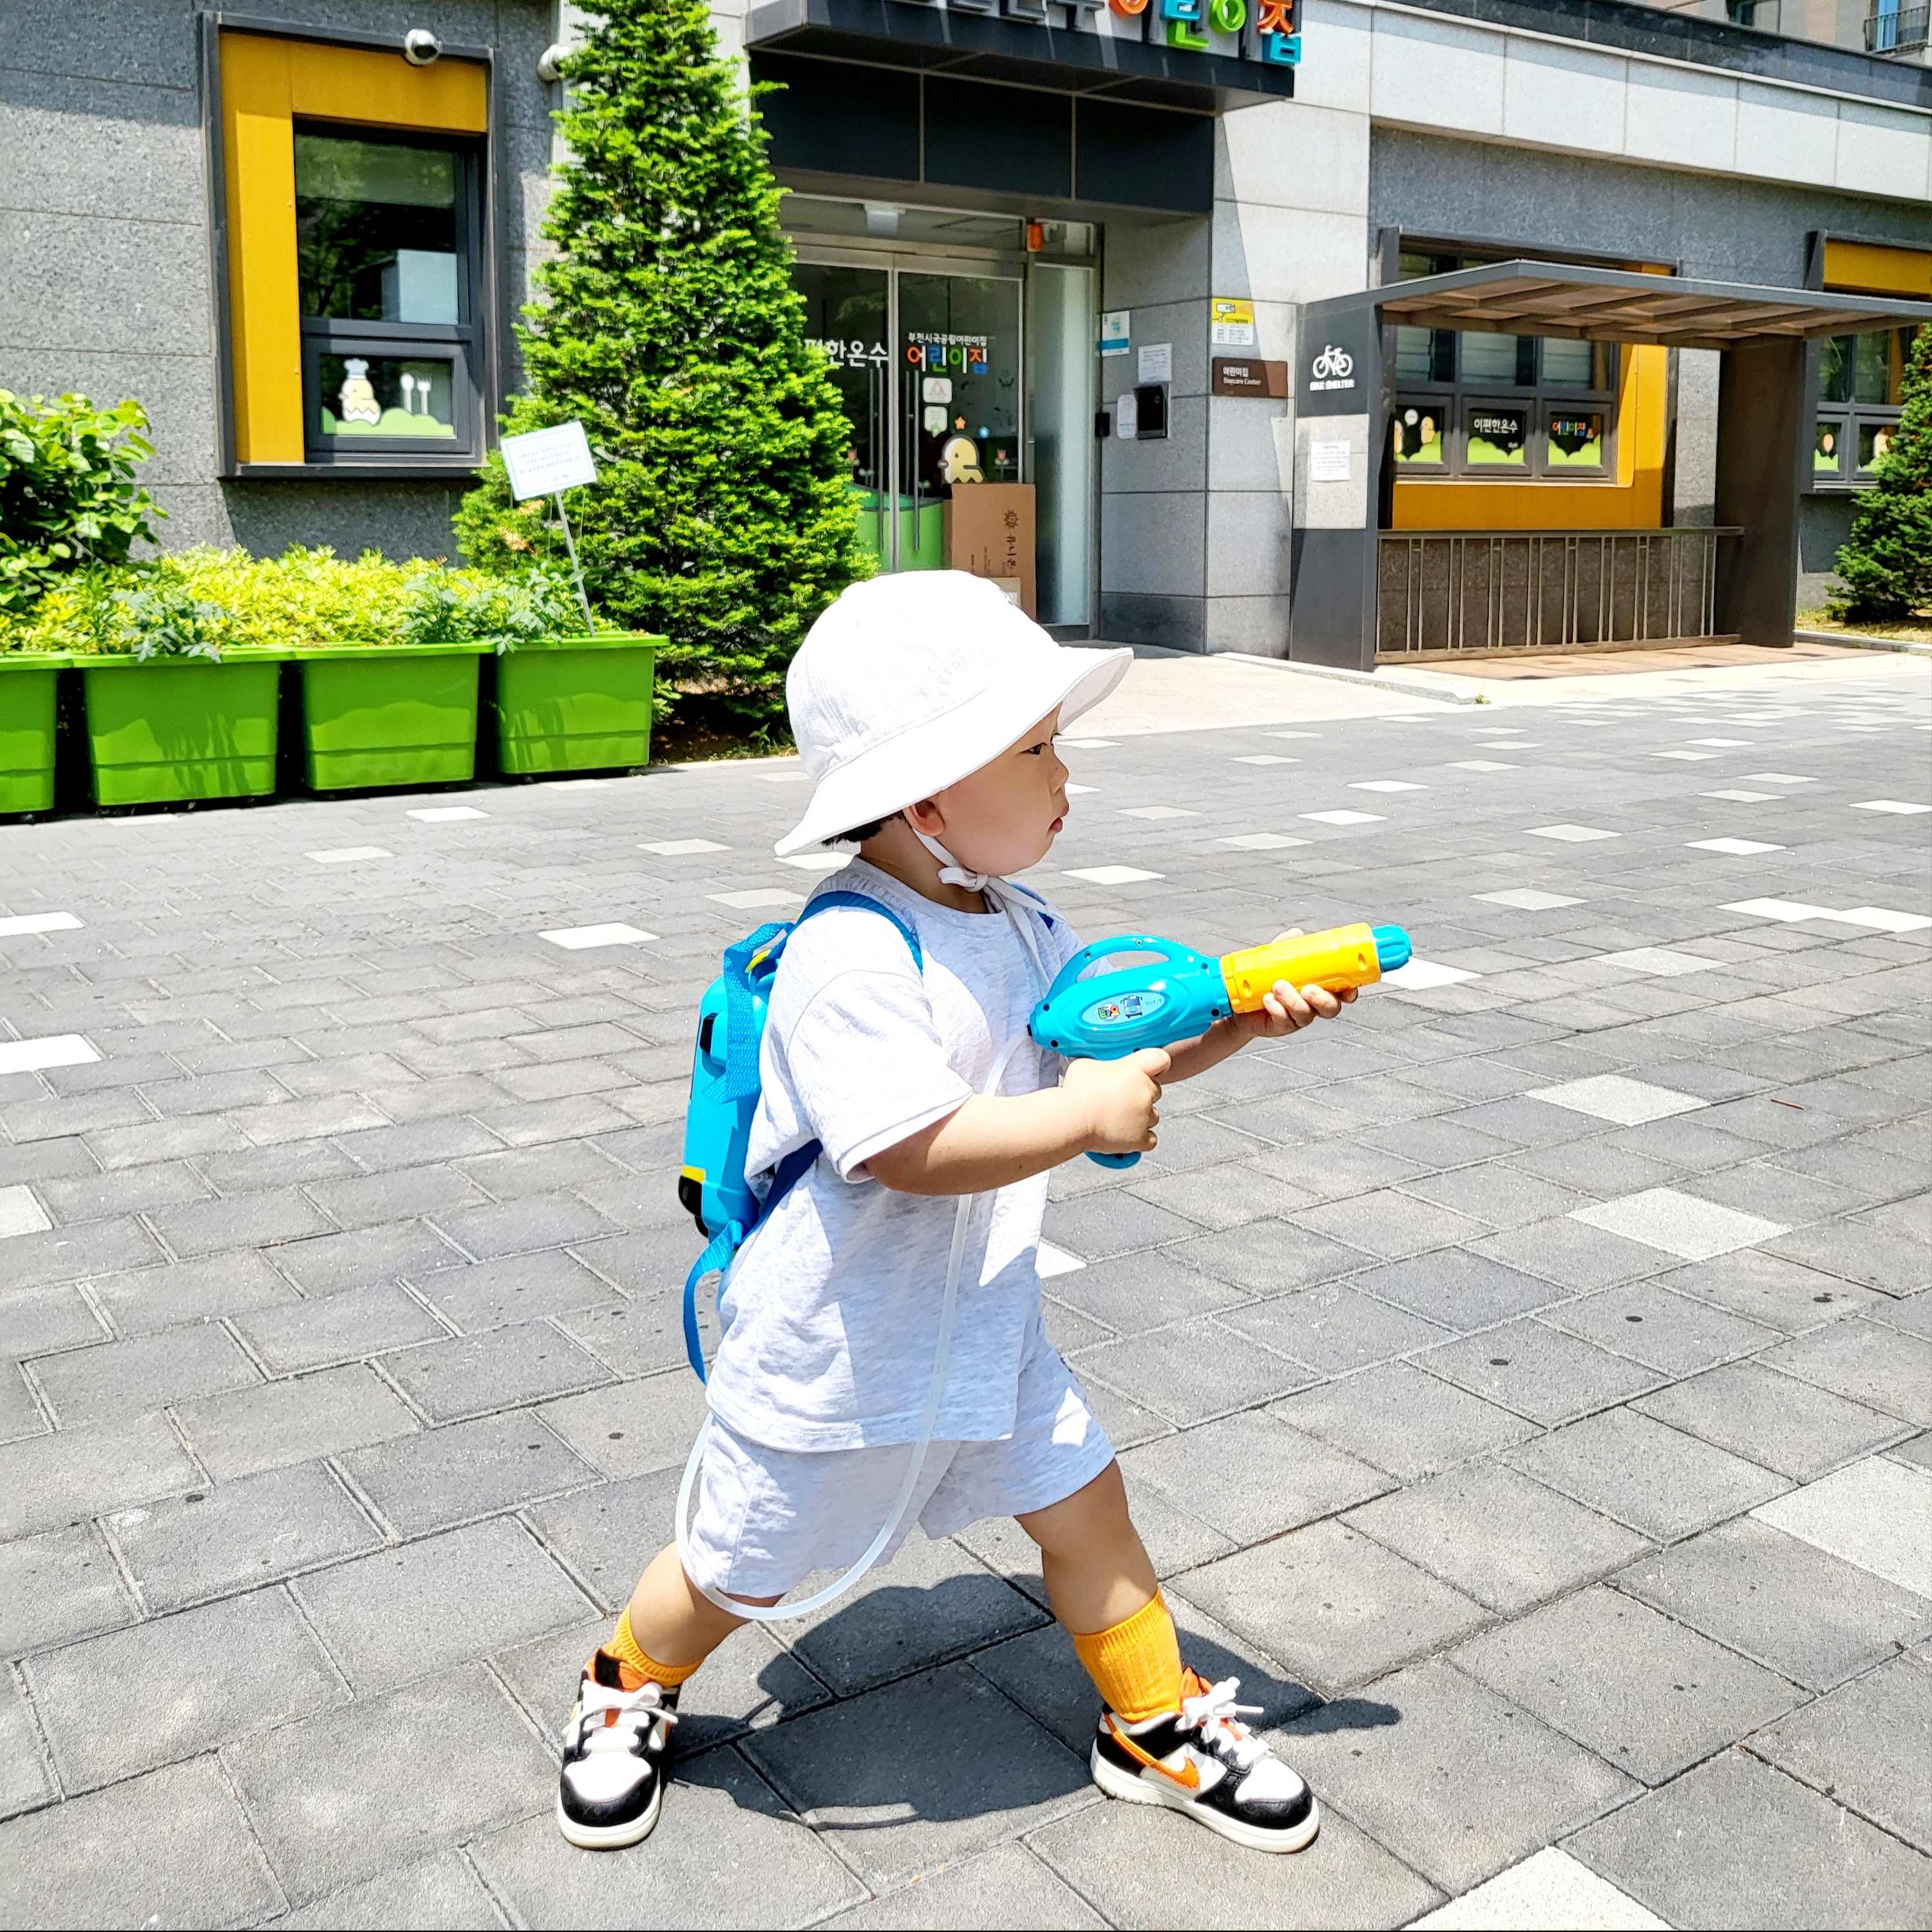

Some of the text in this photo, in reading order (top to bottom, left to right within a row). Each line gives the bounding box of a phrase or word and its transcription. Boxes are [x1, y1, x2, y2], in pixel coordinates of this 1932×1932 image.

[907, 345, 988, 375] 어린이집
[1223, 366, 1249, 378] 어린이집
[1223, 377, 1244, 386] Daycare
[1310, 379, 1355, 392] BIKE SHELTER
[1473, 417, 1519, 433] 이편한온수
[1552, 421, 1586, 436] 어린이집
